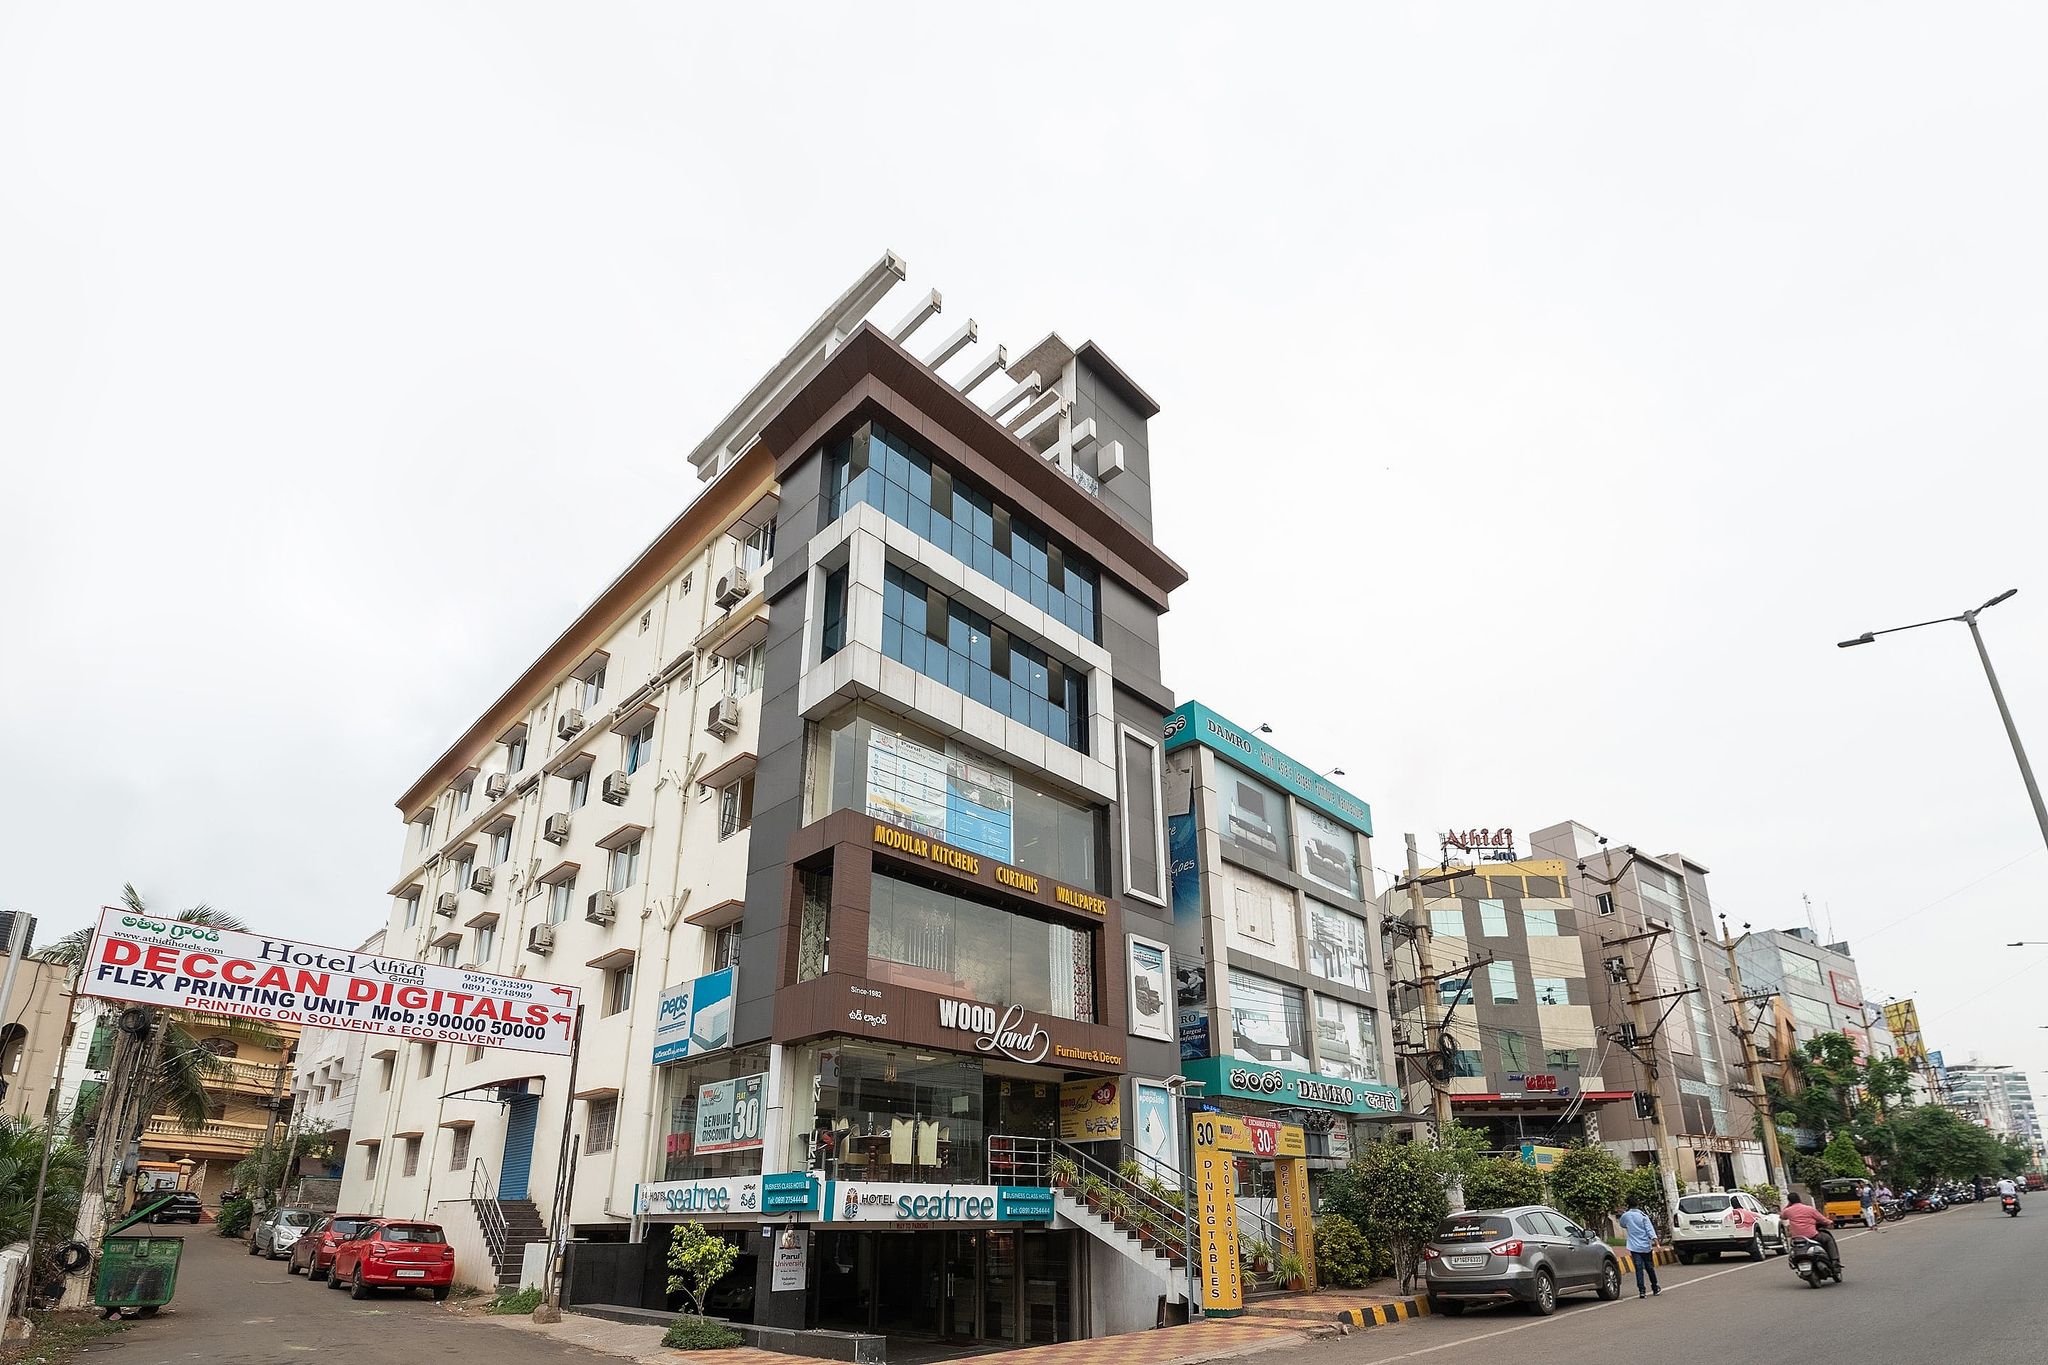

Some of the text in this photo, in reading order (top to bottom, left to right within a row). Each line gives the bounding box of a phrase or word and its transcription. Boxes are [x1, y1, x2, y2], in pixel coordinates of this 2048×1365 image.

[1207, 717, 1253, 754] DAMRO
[874, 824, 929, 859] MODULAR
[931, 844, 980, 876] KITCHENS
[1441, 828, 1514, 849] Athidi
[995, 866, 1039, 895] CURTAINS
[1055, 885, 1107, 916] WALLPAPERS
[113, 931, 225, 955] www.athidihotels.com
[257, 939, 356, 975] Hotel
[358, 957, 428, 979] Athidi
[389, 974, 425, 986] Grand
[101, 938, 549, 1027] DECCAN DIGITALS
[461, 982, 533, 1000] 0891-2748989
[97, 964, 167, 990] FLEX
[174, 976, 296, 1008] PRINTING
[303, 995, 360, 1016] UNIT
[490, 1021, 546, 1041] 50000
[660, 993, 689, 1021] peps
[185, 996, 506, 1046] PRINTING ON SOLVENT & ECO SOLVENT
[939, 998, 1050, 1064] WOOD Land
[1097, 1089, 1110, 1100] 30
[1297, 1078, 1354, 1106] DAMRO
[703, 1112, 732, 1128] GENUINE
[733, 1098, 759, 1140] 30
[1248, 1118, 1277, 1130] EXCHANGE OFFER
[702, 1127, 731, 1142] DISCOUNT
[1196, 1122, 1214, 1146] 30
[1257, 1128, 1271, 1153] 30
[666, 1181, 730, 1212] seatree
[861, 1194, 894, 1205] HOTEL
[1006, 1192, 1026, 1200] BUSINESS
[1280, 1165, 1292, 1210] OFFICE
[896, 1190, 995, 1220] seatree
[1018, 1207, 1030, 1215] 0891
[1203, 1160, 1221, 1299] DINING TABLES
[1223, 1160, 1238, 1299] SOFAS & BEDS
[1299, 1164, 1314, 1288] FURNITURE
[774, 1260, 806, 1268] University
